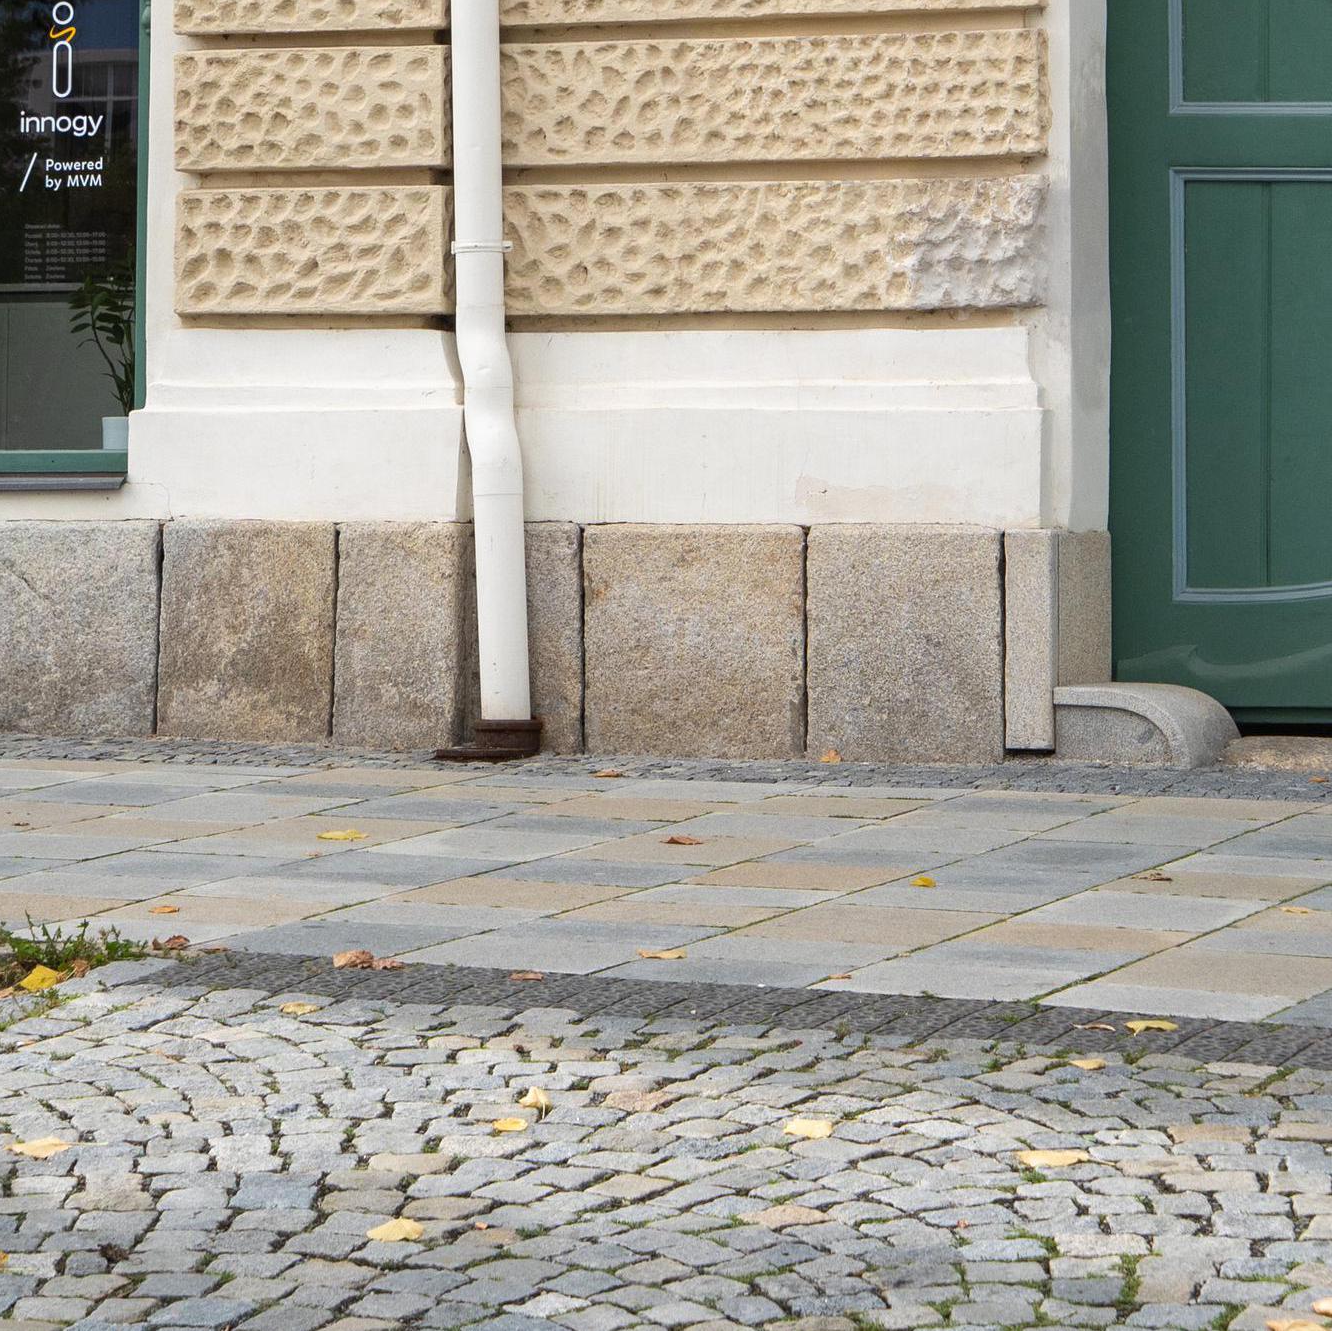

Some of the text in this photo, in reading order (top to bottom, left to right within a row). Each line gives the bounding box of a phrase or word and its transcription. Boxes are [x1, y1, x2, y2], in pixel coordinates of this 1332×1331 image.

[20, 110, 104, 137] innogy
[45, 156, 103, 172] Powered
[45, 173, 103, 192] by MVM
